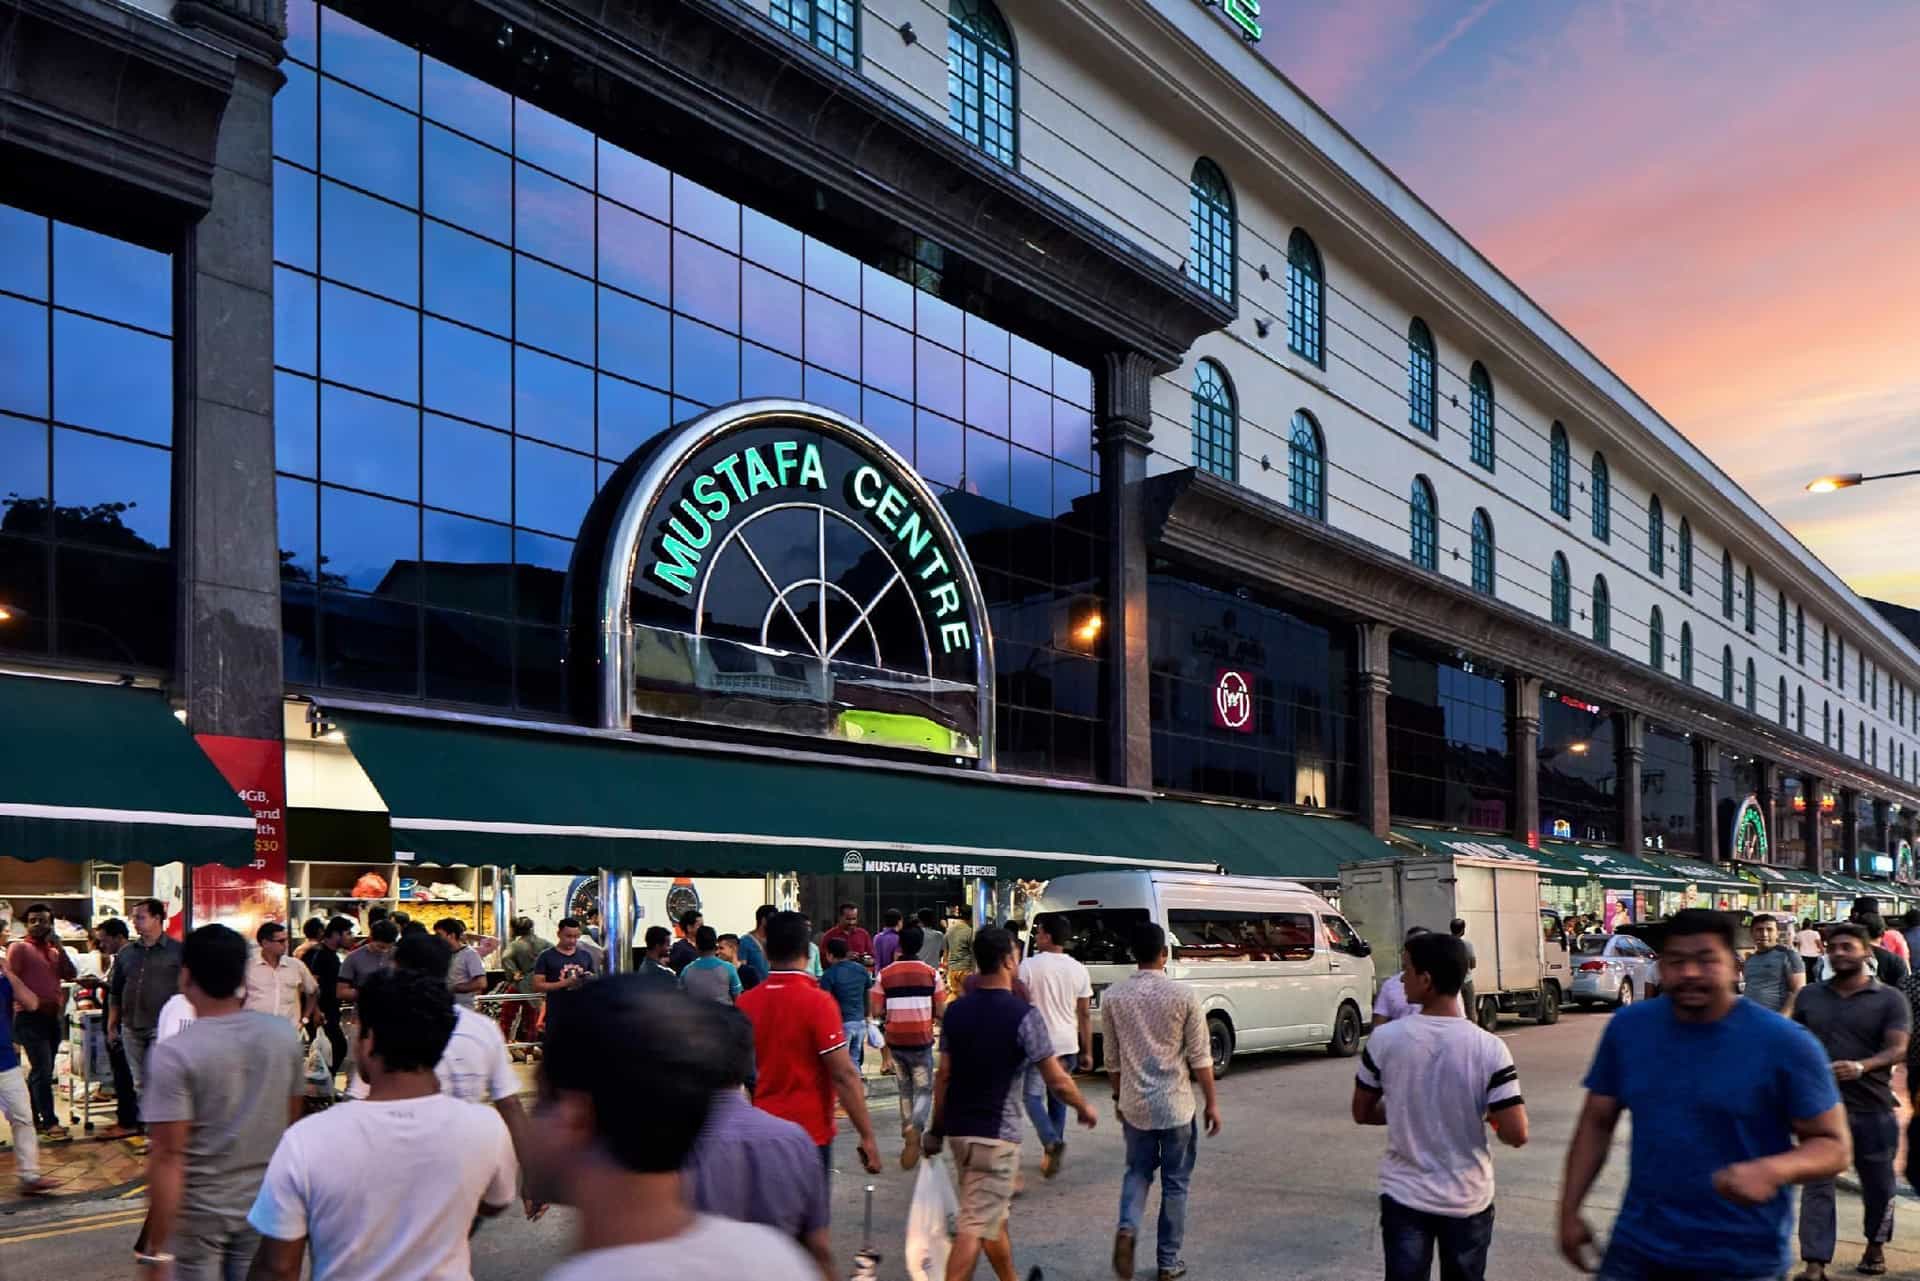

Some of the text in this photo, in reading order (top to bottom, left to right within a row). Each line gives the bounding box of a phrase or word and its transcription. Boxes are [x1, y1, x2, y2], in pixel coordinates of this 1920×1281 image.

[653, 440, 971, 654] MUSTAFA CENTRE
[255, 808, 280, 820] and
[256, 824, 276, 835] ith
[254, 839, 279, 852] $30
[865, 860, 917, 873] MUSTAFA
[919, 863, 961, 876] CENTRE
